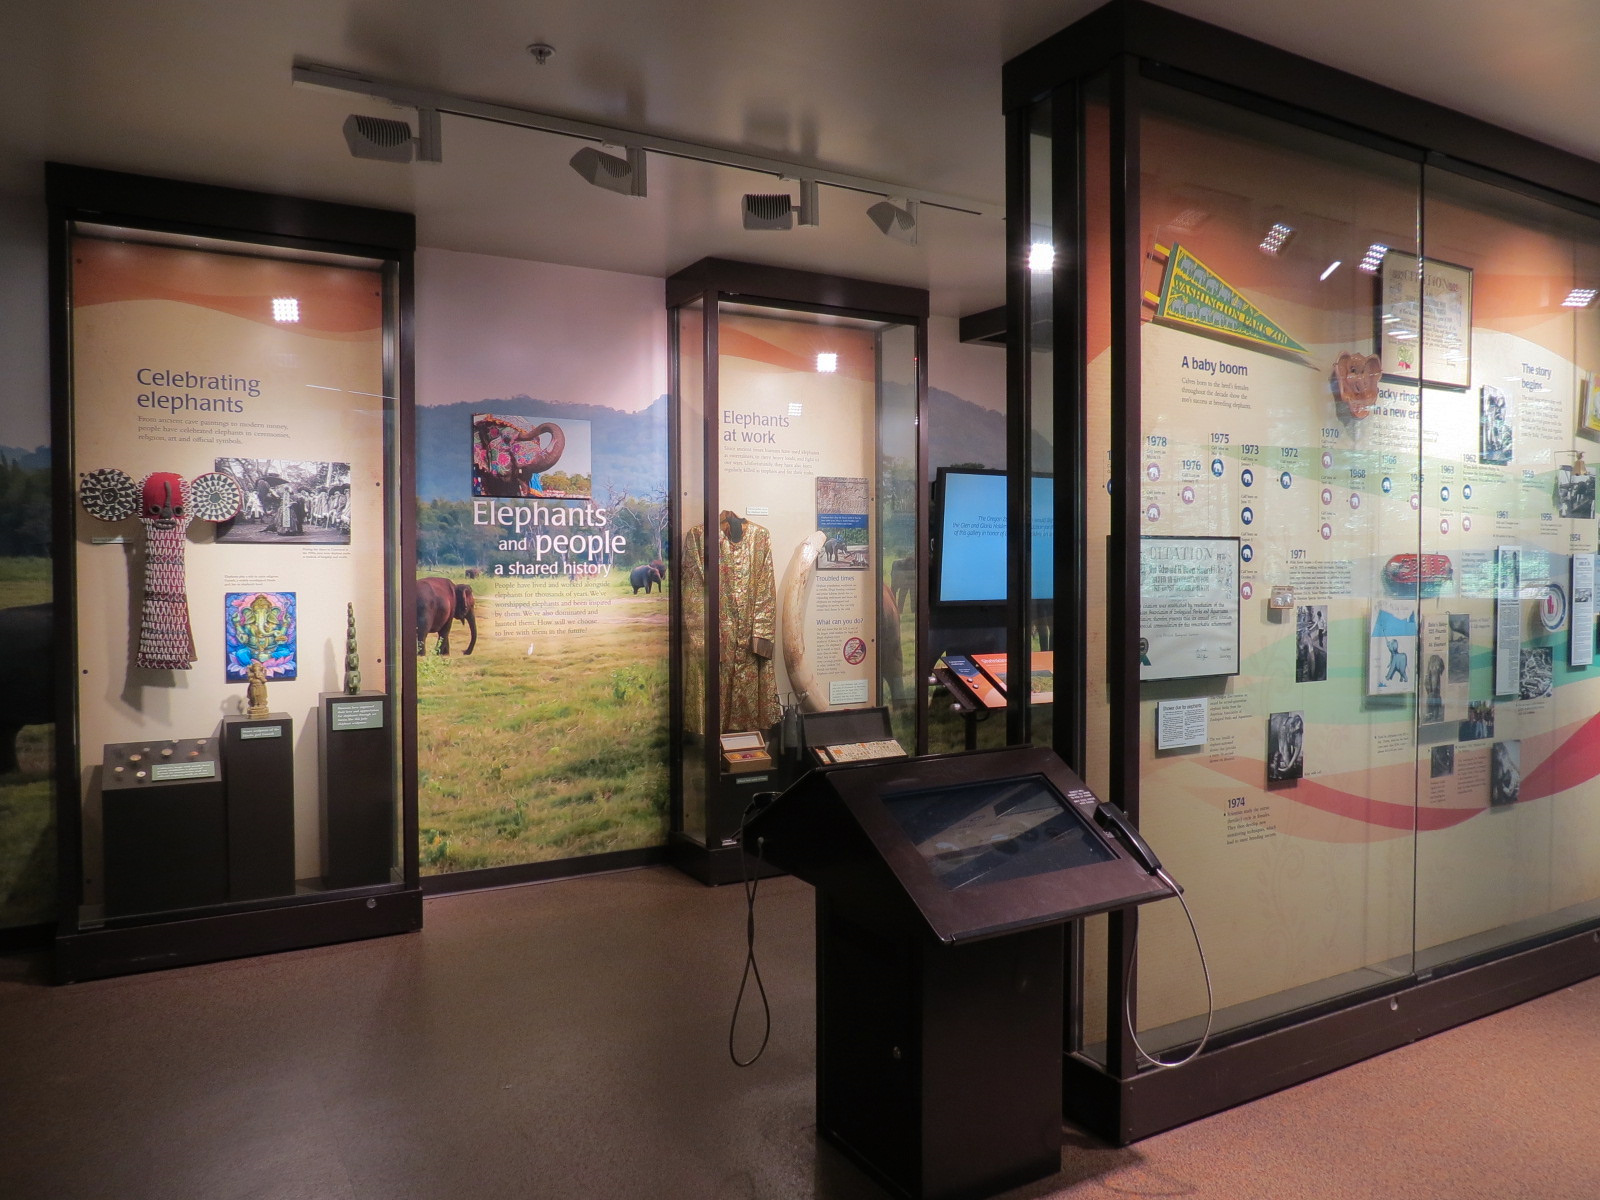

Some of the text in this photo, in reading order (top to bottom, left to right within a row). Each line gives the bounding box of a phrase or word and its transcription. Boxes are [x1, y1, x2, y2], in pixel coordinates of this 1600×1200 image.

[1181, 355, 1248, 376] A baby boom
[1521, 362, 1552, 380] The story
[137, 368, 261, 397] Celebrating
[1521, 378, 1543, 393] begins
[137, 391, 244, 414] elephants
[1377, 387, 1420, 406] acky rings
[1382, 408, 1389, 416] a
[1389, 406, 1406, 418] new
[200, 419, 229, 428] paintings
[239, 421, 265, 429] modern
[723, 410, 790, 428] Elephants
[138, 425, 161, 433] people
[180, 427, 213, 435] celebrated
[214, 428, 243, 437] elephants
[723, 429, 776, 444] at work
[1320, 427, 1339, 439] 1970
[1146, 435, 1167, 447] 1978
[1210, 432, 1230, 444] 1975
[1240, 443, 1260, 455] 1973
[1280, 447, 1298, 458] 1972
[1462, 453, 1477, 463] 1962
[1181, 459, 1201, 471] 1976
[1349, 468, 1366, 480] 1968
[473, 500, 607, 533] Elephants
[498, 530, 626, 561] and people
[1290, 549, 1306, 560] 1971
[494, 561, 612, 578] a shared history
[494, 582, 515, 590] People
[584, 580, 610, 589] alongside
[494, 591, 523, 599] elephants
[535, 590, 564, 598] thousands
[494, 601, 531, 609] worshipped
[531, 600, 560, 609] elephants
[588, 599, 612, 608] inspired
[494, 610, 503, 618] by
[494, 620, 517, 628] hunted
[1227, 796, 1245, 809] 1974
